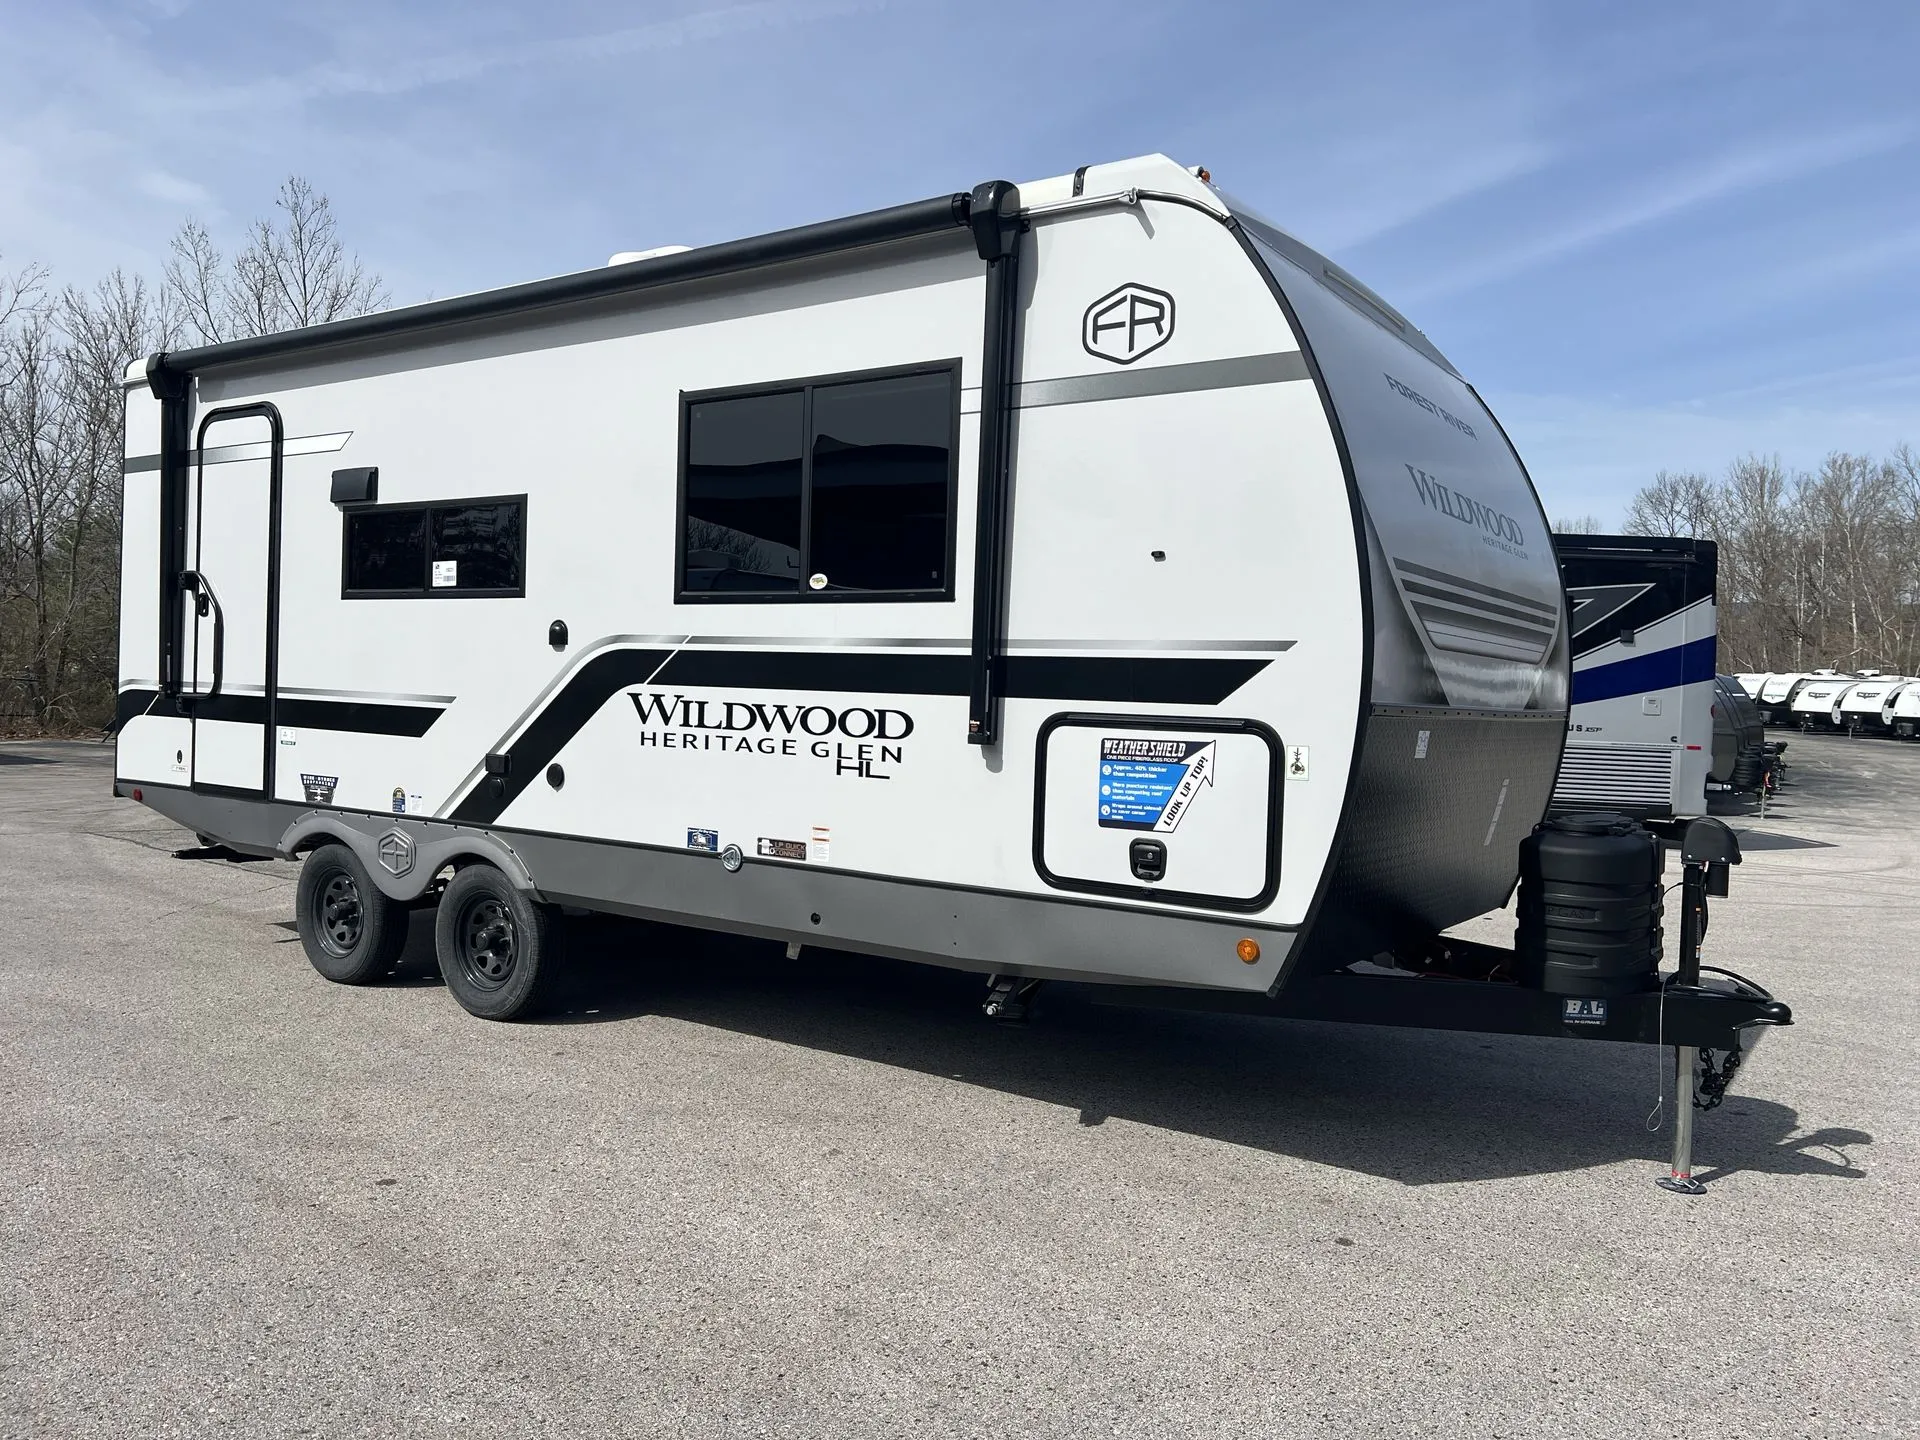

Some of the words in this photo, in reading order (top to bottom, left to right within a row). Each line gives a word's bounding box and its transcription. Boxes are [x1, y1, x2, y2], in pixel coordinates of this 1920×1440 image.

[1092, 293, 1165, 353] FR
[1383, 372, 1440, 418] FOREST
[1439, 408, 1477, 440] RIVER
[1404, 463, 1524, 546] WILDWOOD
[1482, 535, 1513, 555] HERITAGE
[627, 692, 914, 740] WILDWOOD
[640, 731, 797, 756] HERITAGE
[811, 741, 902, 763] GLEN
[836, 759, 890, 779] HL
[1163, 799, 1183, 827] LOOK
[1180, 781, 1191, 798] UP
[1190, 755, 1209, 780] TOP!
[774, 849, 805, 859] CONNECT
[786, 843, 805, 851] QUICK
